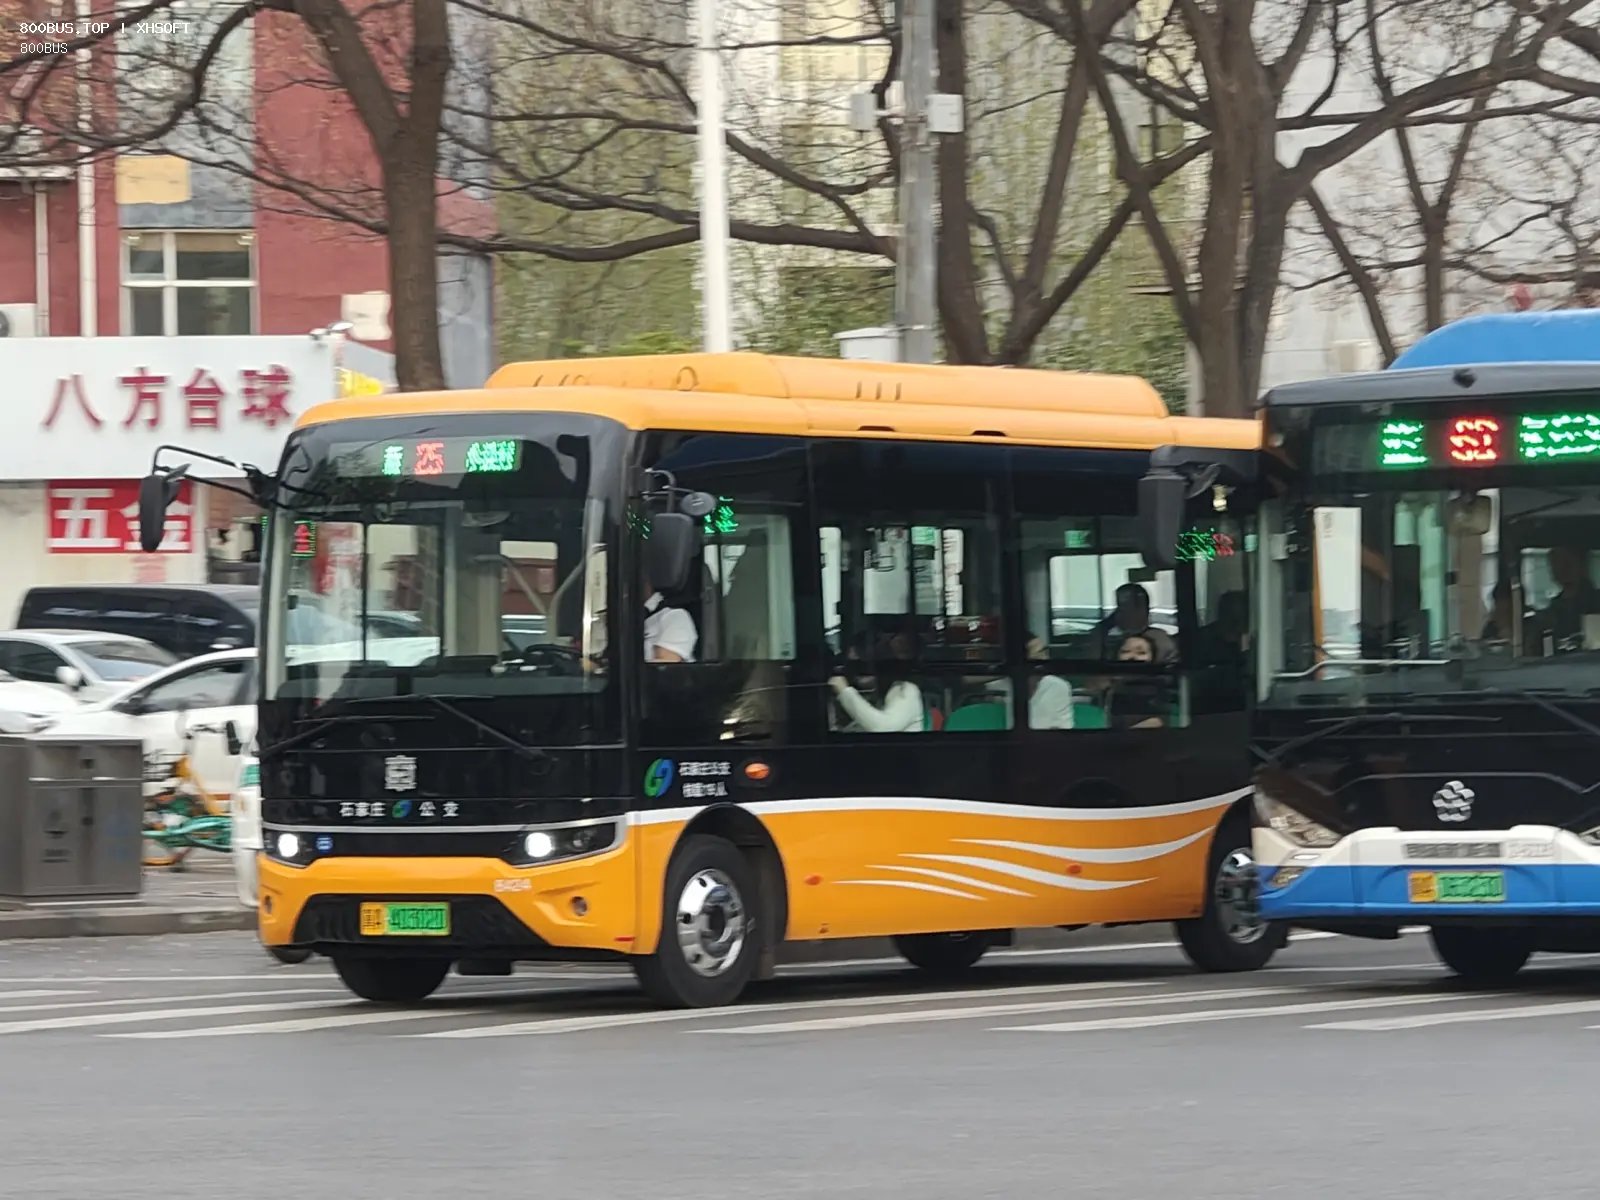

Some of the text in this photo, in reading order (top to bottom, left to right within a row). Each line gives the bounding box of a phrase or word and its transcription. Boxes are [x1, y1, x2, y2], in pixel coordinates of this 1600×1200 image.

[42, 364, 294, 430] 八方台球
[47, 487, 193, 551] 五金
